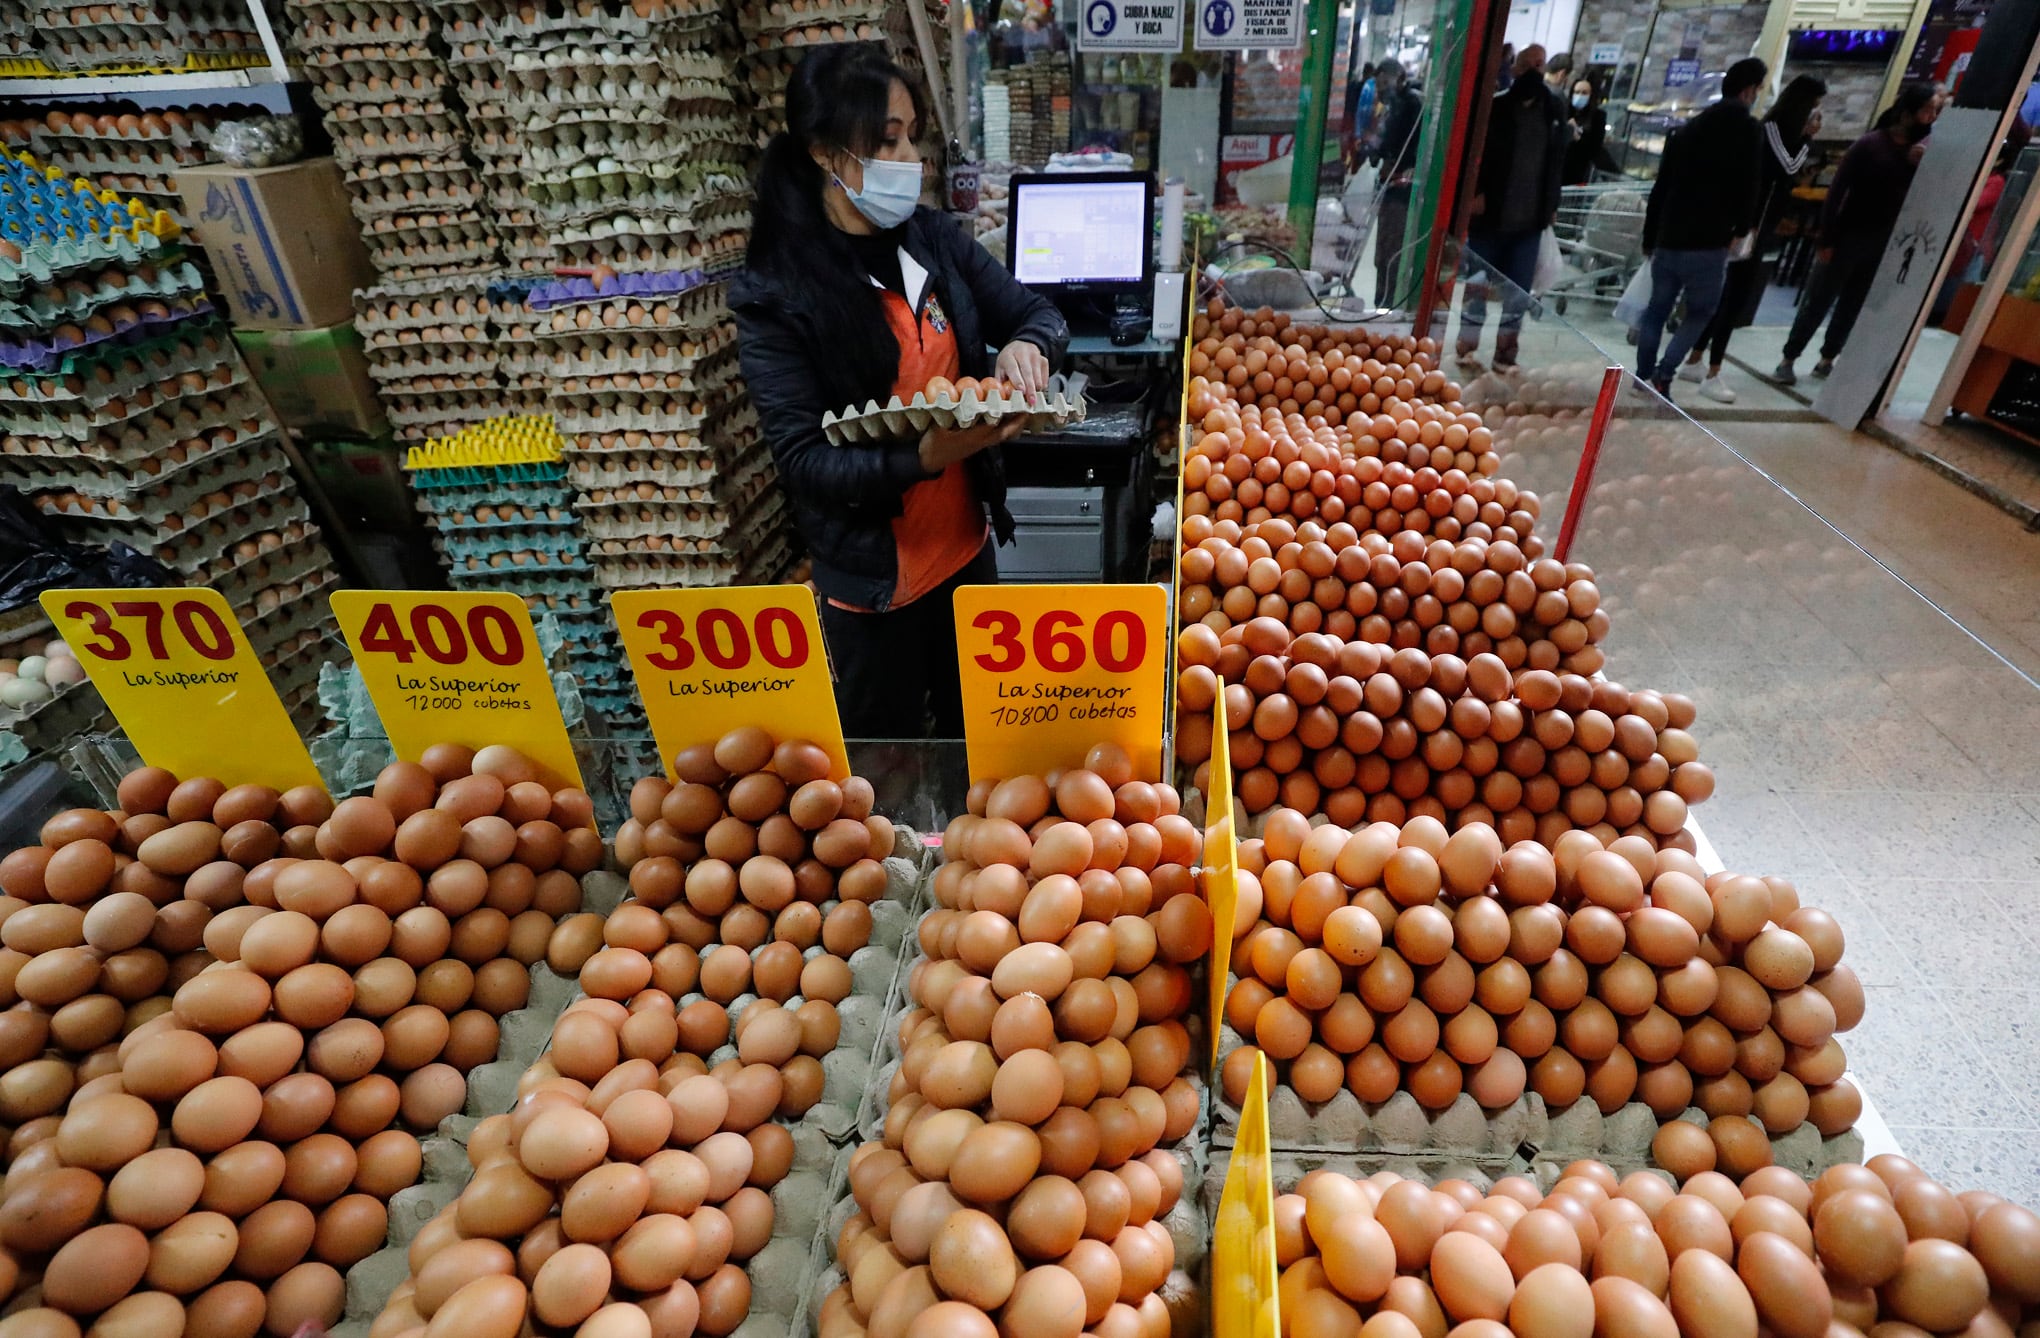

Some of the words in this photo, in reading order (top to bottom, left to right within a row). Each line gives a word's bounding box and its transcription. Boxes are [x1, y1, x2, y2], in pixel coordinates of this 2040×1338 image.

[1124, 6, 1149, 18] CUBRA
[1151, 6, 1174, 18] NARIZ
[1244, 9, 1291, 17] DISTANCIA
[1135, 22, 1140, 34] Y
[1143, 22, 1162, 34] BOCA
[65, 600, 235, 660] 370
[359, 604, 524, 665] 400
[637, 607, 809, 670] 300
[972, 610, 1146, 673] 360
[123, 671, 152, 686] La
[154, 670, 238, 690] Superior
[397, 674, 426, 689] La
[430, 676, 520, 696] Superior
[669, 680, 698, 696] La
[702, 677, 795, 698] Superior
[999, 682, 1030, 698] La
[1032, 683, 1131, 700] Superior
[405, 695, 462, 711] 12000
[474, 696, 531, 710] cubetas
[990, 703, 1059, 727] 10800
[1069, 702, 1136, 720] cubetas
